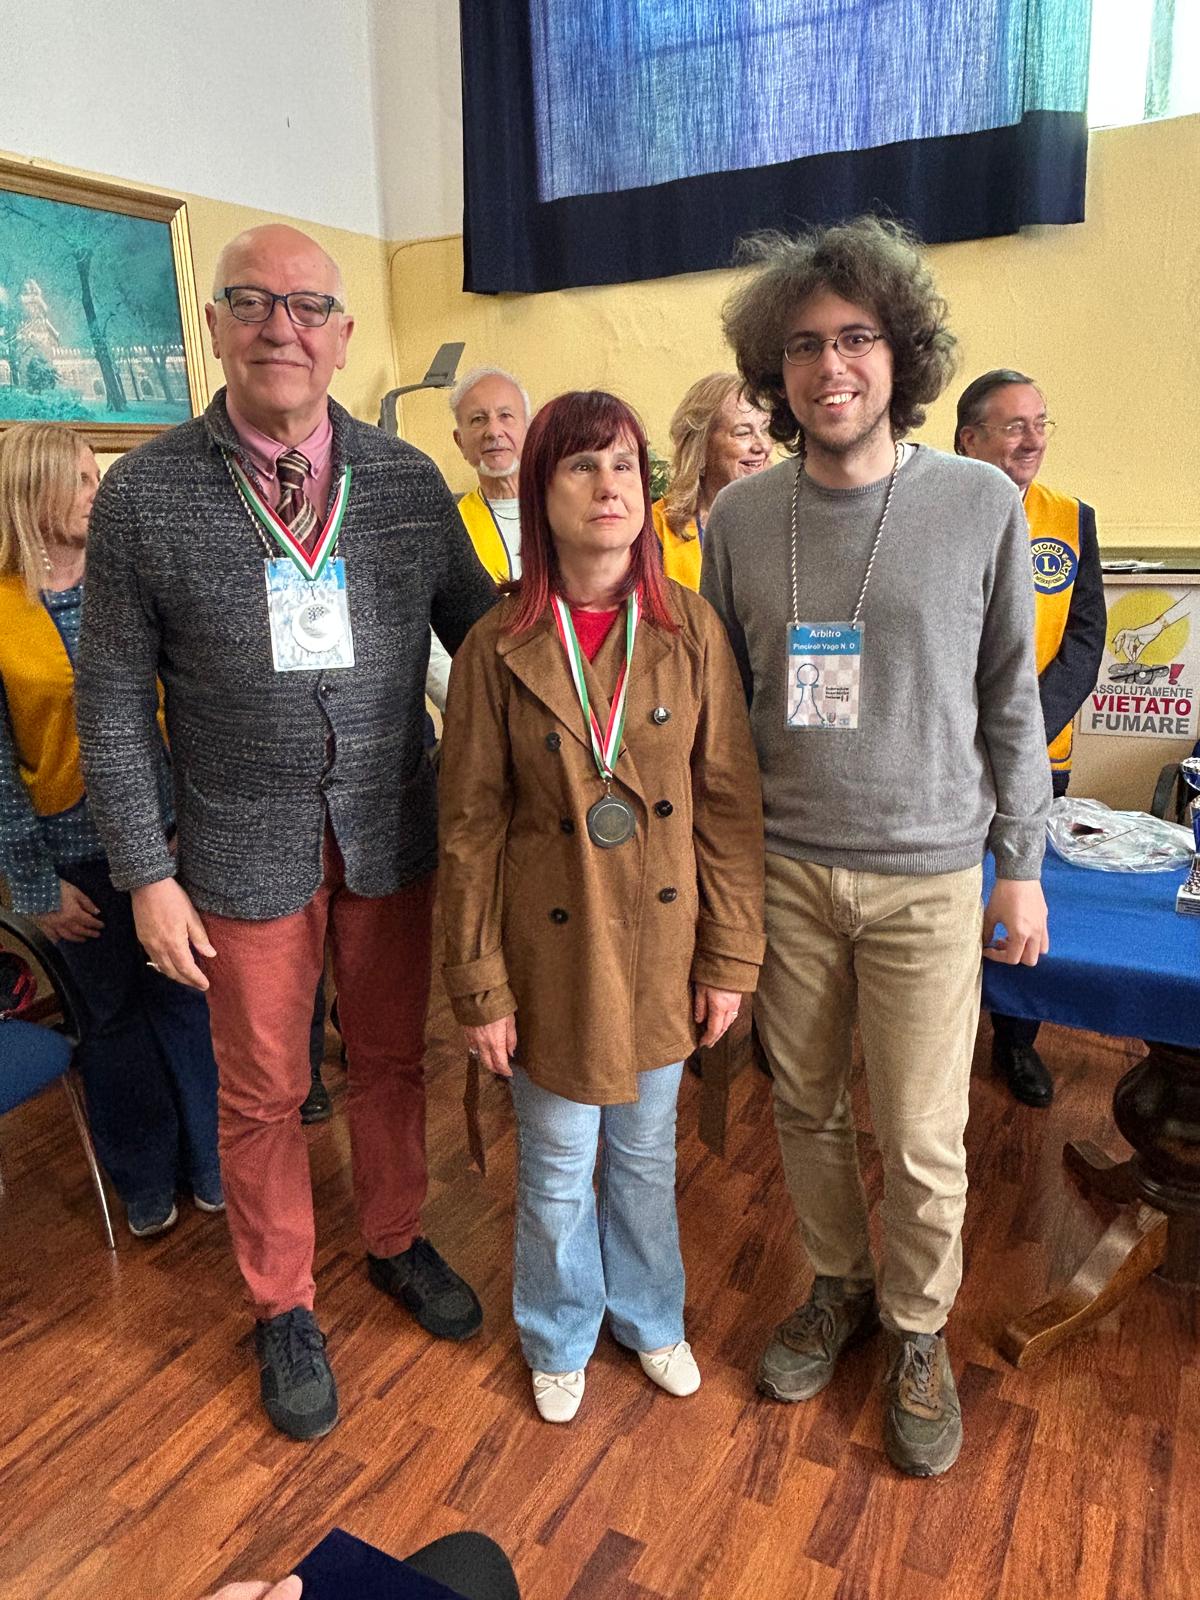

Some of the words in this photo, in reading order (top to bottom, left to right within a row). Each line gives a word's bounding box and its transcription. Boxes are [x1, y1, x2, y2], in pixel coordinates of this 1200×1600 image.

[1033, 543, 1062, 553] LIONS
[1042, 556, 1056, 572] L
[809, 630, 841, 638] Arbitro
[1094, 685, 1193, 698] ASSOLUTAMENTE
[1092, 694, 1192, 716] VIETATO
[1091, 713, 1190, 735] FUMARE
